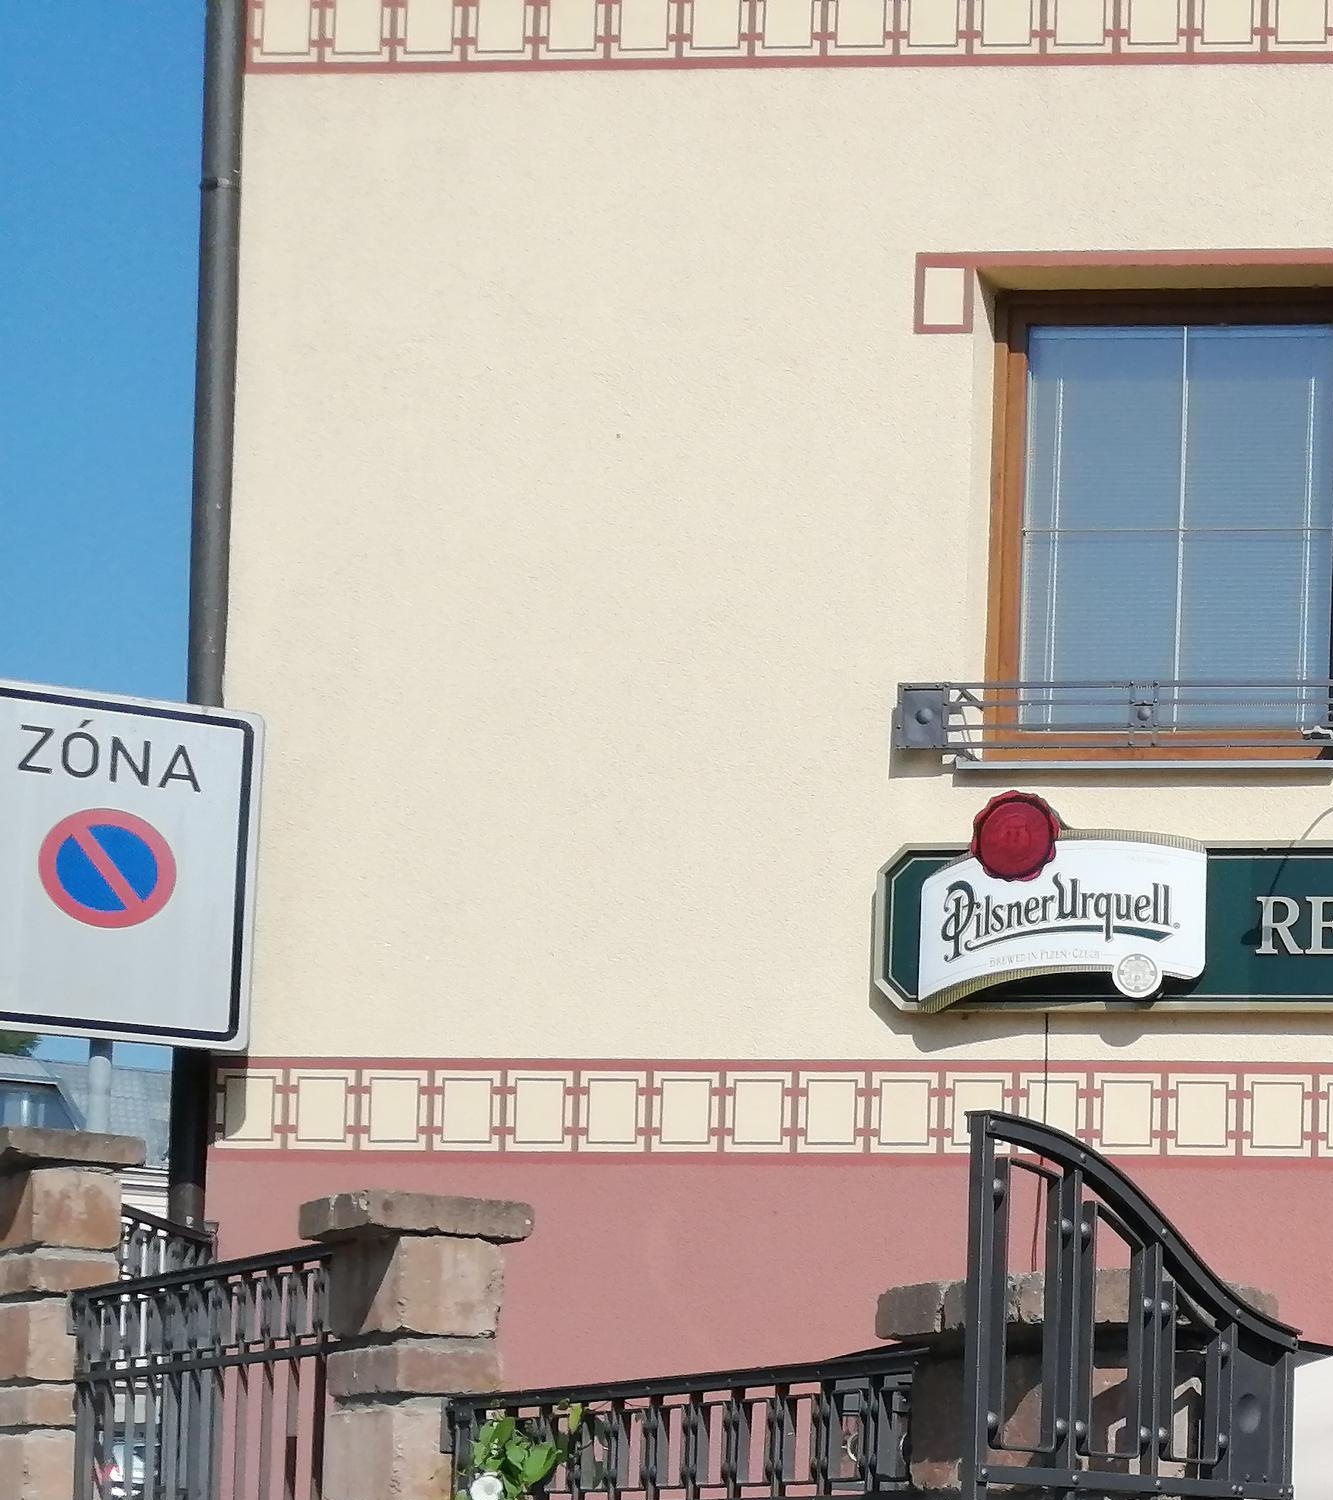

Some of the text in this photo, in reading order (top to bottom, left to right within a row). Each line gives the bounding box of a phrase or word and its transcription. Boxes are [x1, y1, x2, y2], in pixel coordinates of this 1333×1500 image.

[18, 719, 201, 793] ZÓNA
[940, 872, 1173, 963] Pilsner Urquell
